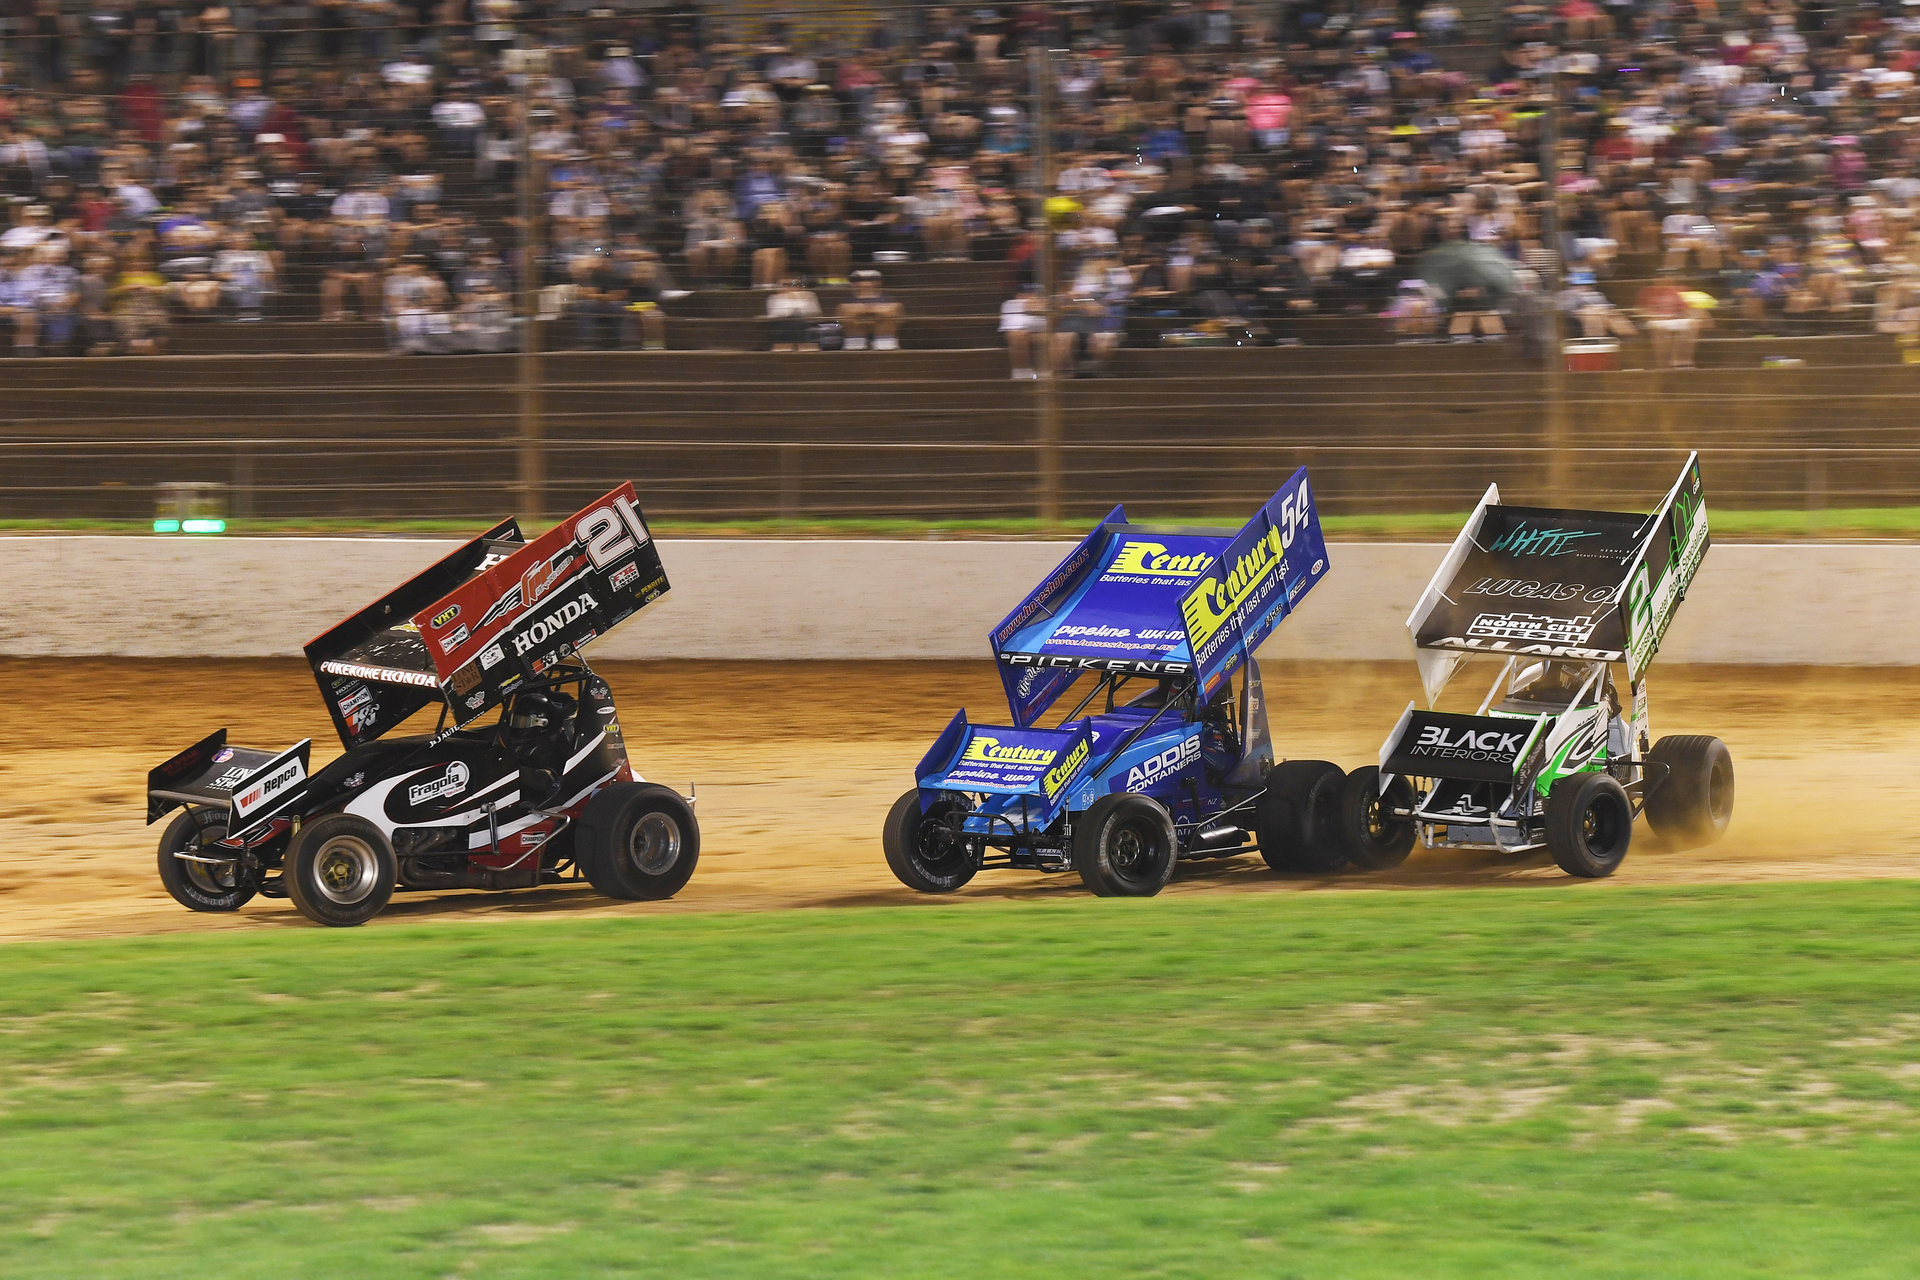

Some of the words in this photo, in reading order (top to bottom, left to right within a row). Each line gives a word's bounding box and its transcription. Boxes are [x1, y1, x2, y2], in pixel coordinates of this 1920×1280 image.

[1281, 477, 1310, 549] 54
[574, 494, 650, 574] 21
[1490, 521, 1601, 556] WHITE
[640, 575, 665, 594] PENRITE
[1099, 574, 1150, 585] Batteries
[1150, 576, 1174, 586] that
[1182, 524, 1284, 655] Century
[1463, 577, 1585, 601] LUCAS
[434, 607, 455, 625] VHT
[1629, 561, 1652, 658] 2
[511, 592, 598, 657] HONDA
[1053, 624, 1131, 637] pipeline
[1195, 625, 1230, 669] Batteries
[1245, 590, 1261, 615] last
[1260, 580, 1276, 598] and
[1471, 627, 1585, 641] DIESEL
[1479, 618, 1544, 629] NORTH
[1546, 623, 1588, 632] CITY
[443, 630, 467, 649] CHAMPION
[1428, 637, 1623, 661] ALLARD
[320, 661, 380, 680] PUKEKOHE
[380, 668, 437, 688] HONDA
[1010, 655, 1188, 674] PICKENS
[343, 692, 368, 711] CHAMPION
[961, 736, 1057, 765] Century
[1417, 725, 1524, 753] BLACK
[958, 760, 989, 768] Batteries
[1126, 734, 1201, 788] ADDIS
[1410, 745, 1515, 763] INTERIORS
[263, 765, 297, 795] Repco
[947, 769, 1000, 780] pipeline
[1043, 738, 1089, 799] Century
[1126, 750, 1201, 793] CONTAINERS
[410, 774, 460, 799] Fragola
[911, 858, 951, 888] Hoosier
[184, 884, 234, 907] Hoosier
